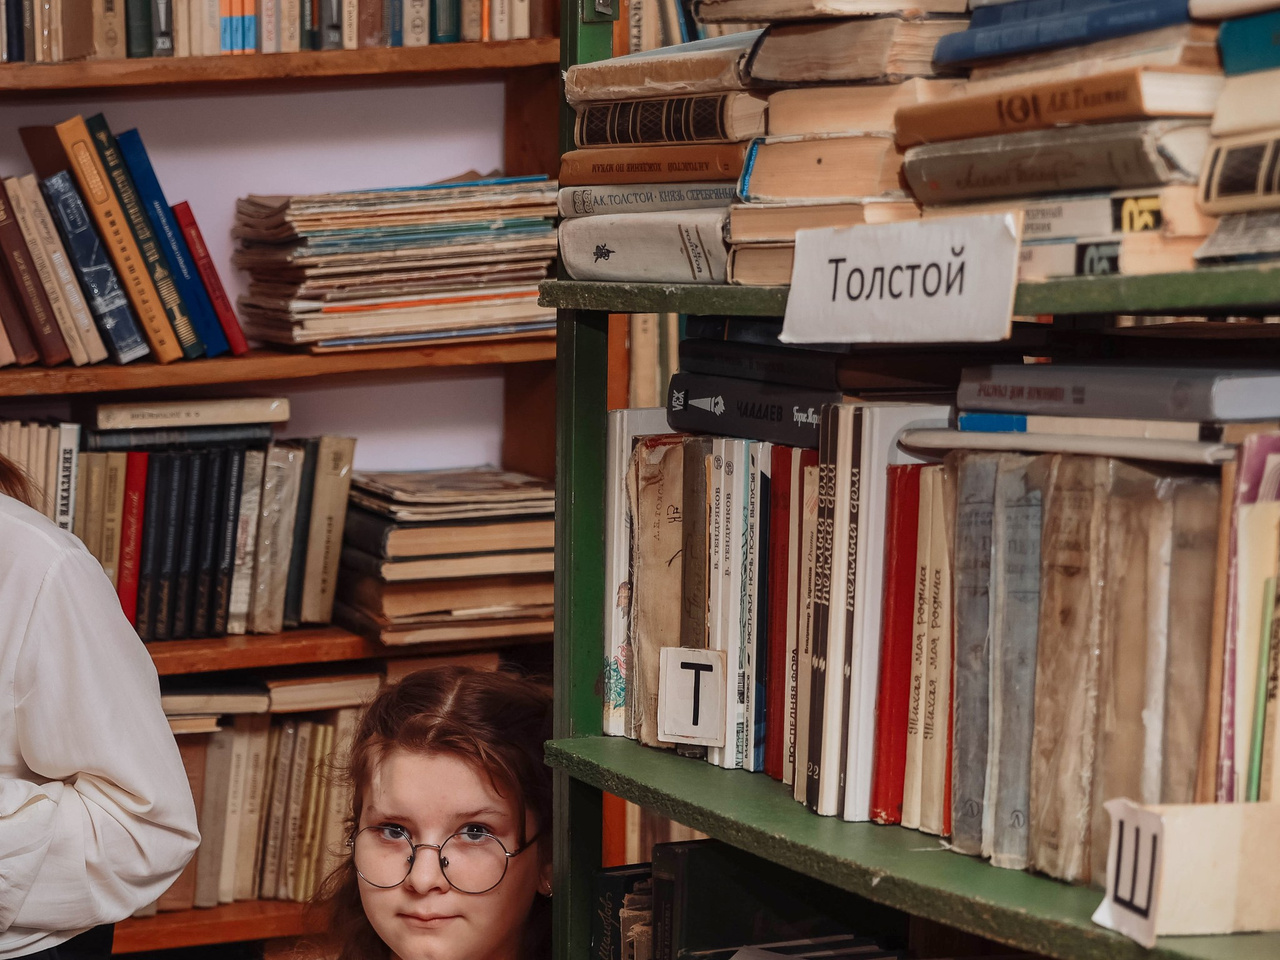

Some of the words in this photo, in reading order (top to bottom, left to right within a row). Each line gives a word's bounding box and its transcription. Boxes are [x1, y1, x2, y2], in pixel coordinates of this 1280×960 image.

[103, 146, 119, 167] ВЕК
[591, 163, 614, 174] МУКАМ
[614, 163, 624, 174] ПО
[625, 162, 661, 173] ХОЖДЕНИЕ
[112, 165, 151, 242] ДЕВЯТНАДЦАТЫЙ
[658, 190, 684, 202] КНЯЗЬ
[102, 205, 157, 326] ЧЕРНЫШЕВСКИЙ
[142, 239, 160, 263] НАШ
[683, 226, 703, 274] ТОЛСТОЙ
[11, 246, 48, 327] ЧЕРНЫШЕВСКИЙ
[827, 246, 966, 303] Толстой
[671, 389, 684, 411] ЖЗЛ
[735, 399, 784, 423] ЧААДАЕВ
[59, 447, 72, 516] НАКАЗАНИЕ
[817, 463, 829, 507] дом
[825, 463, 837, 508] дом
[848, 467, 861, 513] дом
[714, 559, 720, 569] В.
[806, 530, 814, 562] Охота
[724, 566, 731, 575] В.
[747, 557, 755, 586] НОЧЬ
[914, 563, 929, 625] родина
[929, 567, 945, 629] родина
[745, 593, 753, 644] РАСПЛАТА
[803, 611, 811, 654] Владимир
[789, 647, 798, 682] ФОРА
[913, 630, 925, 665] моя
[927, 635, 940, 669] моя
[680, 661, 713, 726] Т
[907, 672, 923, 734] Тихая
[922, 676, 937, 739] Тихая
[786, 685, 798, 763] ПОСЛЕДНЯЯ
[1113, 817, 1158, 918] Ш
[662, 902, 672, 945] ЦЕЛИНА
